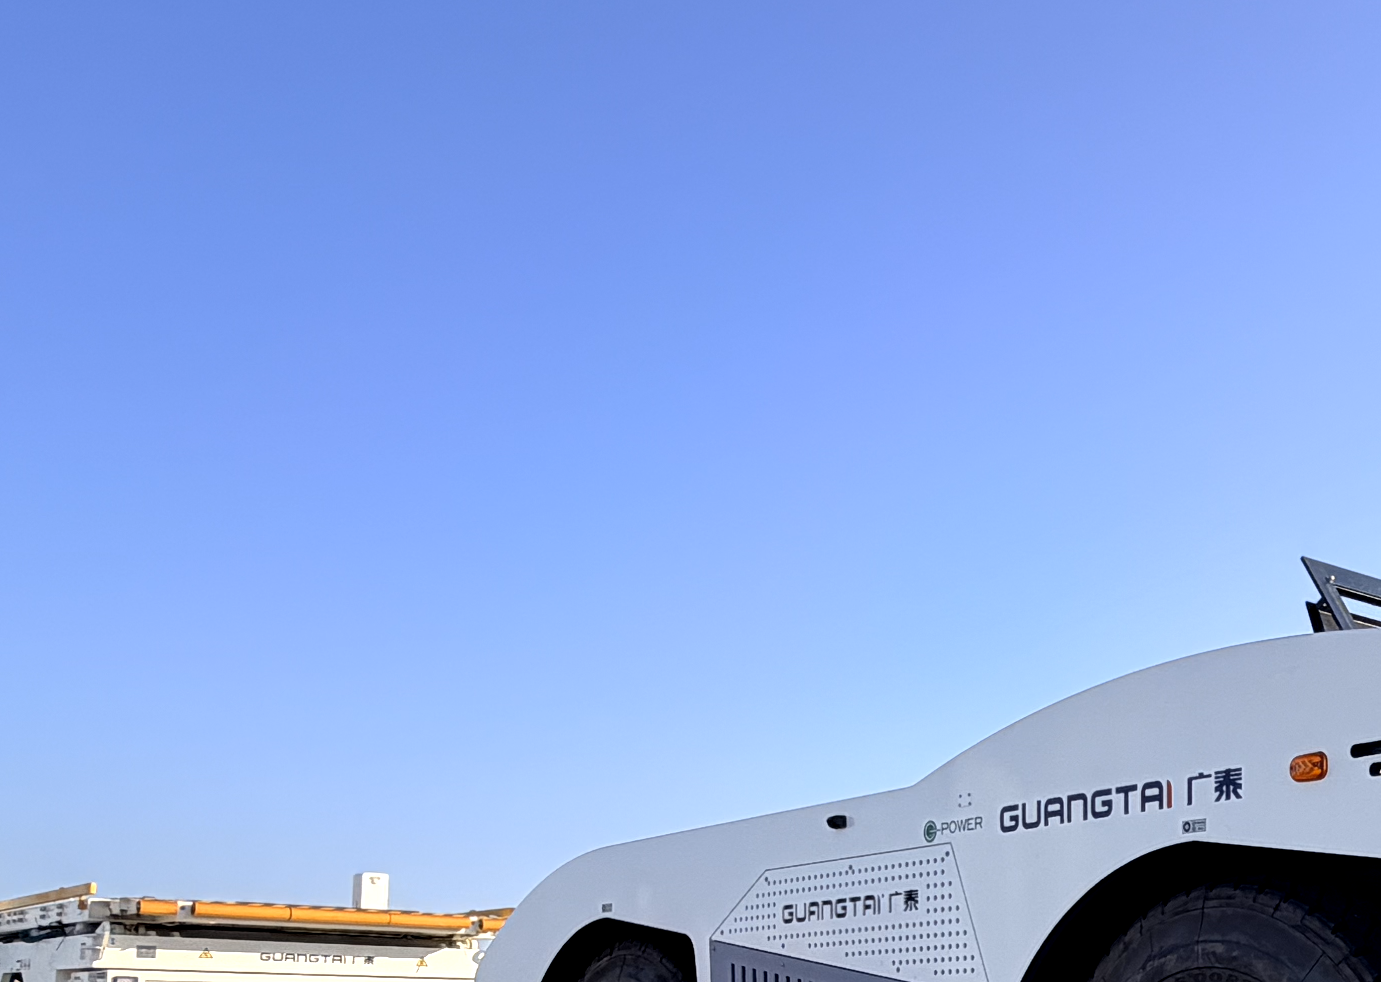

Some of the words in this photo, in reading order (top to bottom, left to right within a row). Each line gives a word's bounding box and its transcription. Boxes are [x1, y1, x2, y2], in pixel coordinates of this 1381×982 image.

[1000, 780, 1173, 833] GUANGTAI
[1187, 767, 1243, 807] 广泰
[782, 895, 881, 924] GUANGTAI
[889, 889, 919, 913] 广泰
[260, 952, 347, 964] GUANGTAI
